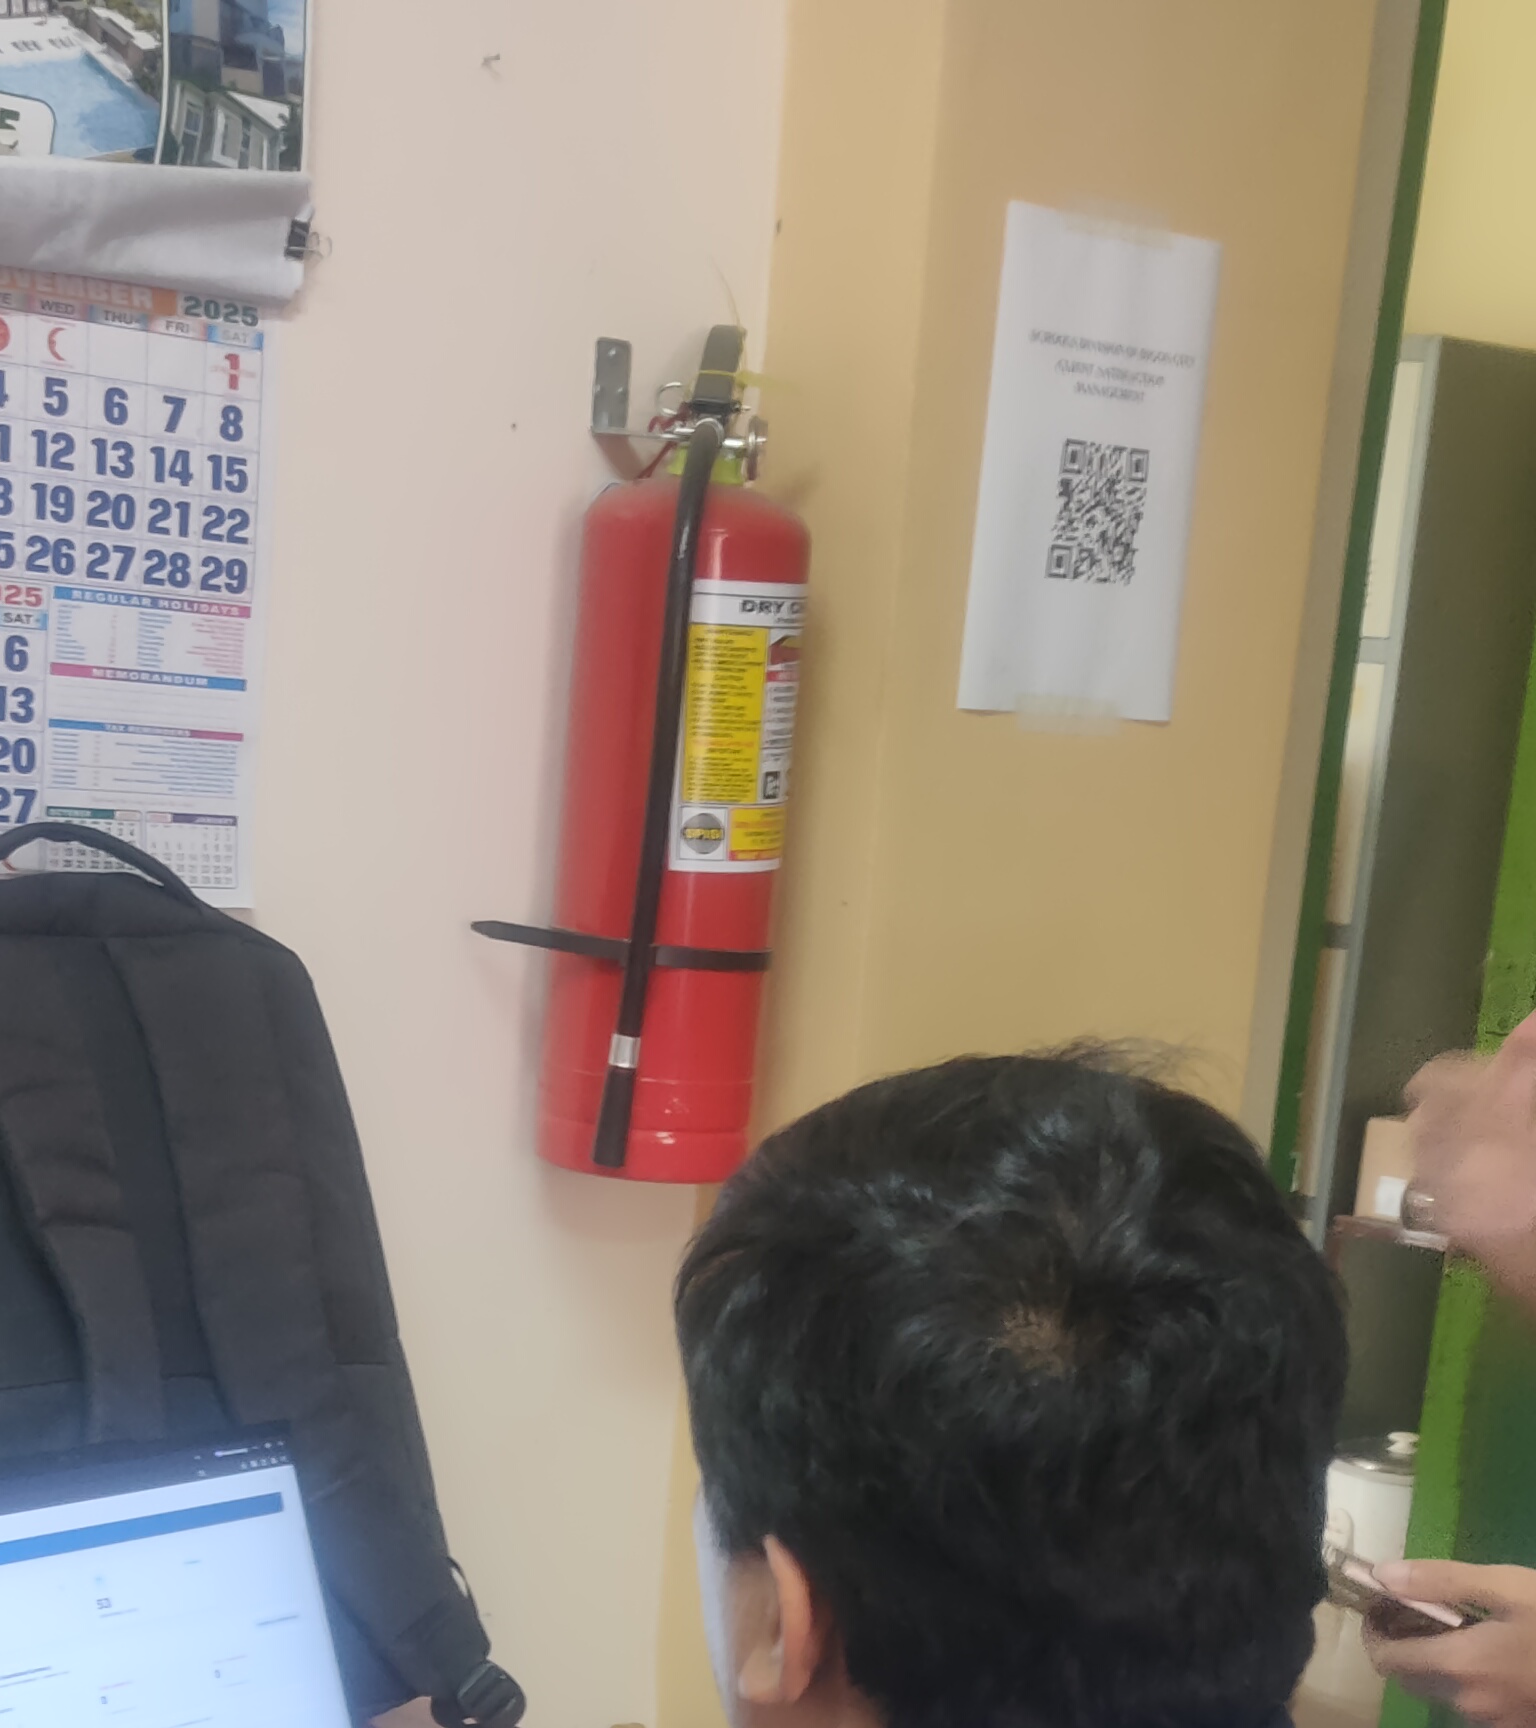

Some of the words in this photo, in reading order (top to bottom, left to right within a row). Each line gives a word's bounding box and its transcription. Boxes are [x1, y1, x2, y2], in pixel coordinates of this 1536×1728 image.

[40, 300, 76, 316] WED
[103, 309, 134, 325] THU
[165, 319, 191, 335] FRI
[221, 328, 250, 344] SAT
[182, 295, 260, 328] 2025
[224, 353, 240, 390] 1
[43, 377, 68, 416] 5
[104, 387, 128, 425] 6
[163, 395, 186, 433] 7
[220, 405, 243, 442] 8
[31, 429, 75, 471] 12
[91, 438, 134, 478] 13
[150, 446, 193, 486] 14
[207, 454, 248, 493] 15
[30, 483, 75, 523] 19
[86, 490, 136, 530] 20
[148, 498, 190, 538] 21
[202, 505, 250, 544] 22
[25, 535, 76, 575] 26
[86, 542, 136, 581] 27
[143, 549, 191, 588] 28
[200, 556, 247, 594] 29
[3, 611, 32, 625] SAT
[71, 589, 153, 608] REGULAR
[158, 597, 241, 616] HOLIDAYS
[740, 599, 785, 615] DRY
[4, 635, 28, 672] 6
[91, 667, 209, 687] MEMORANDUM
